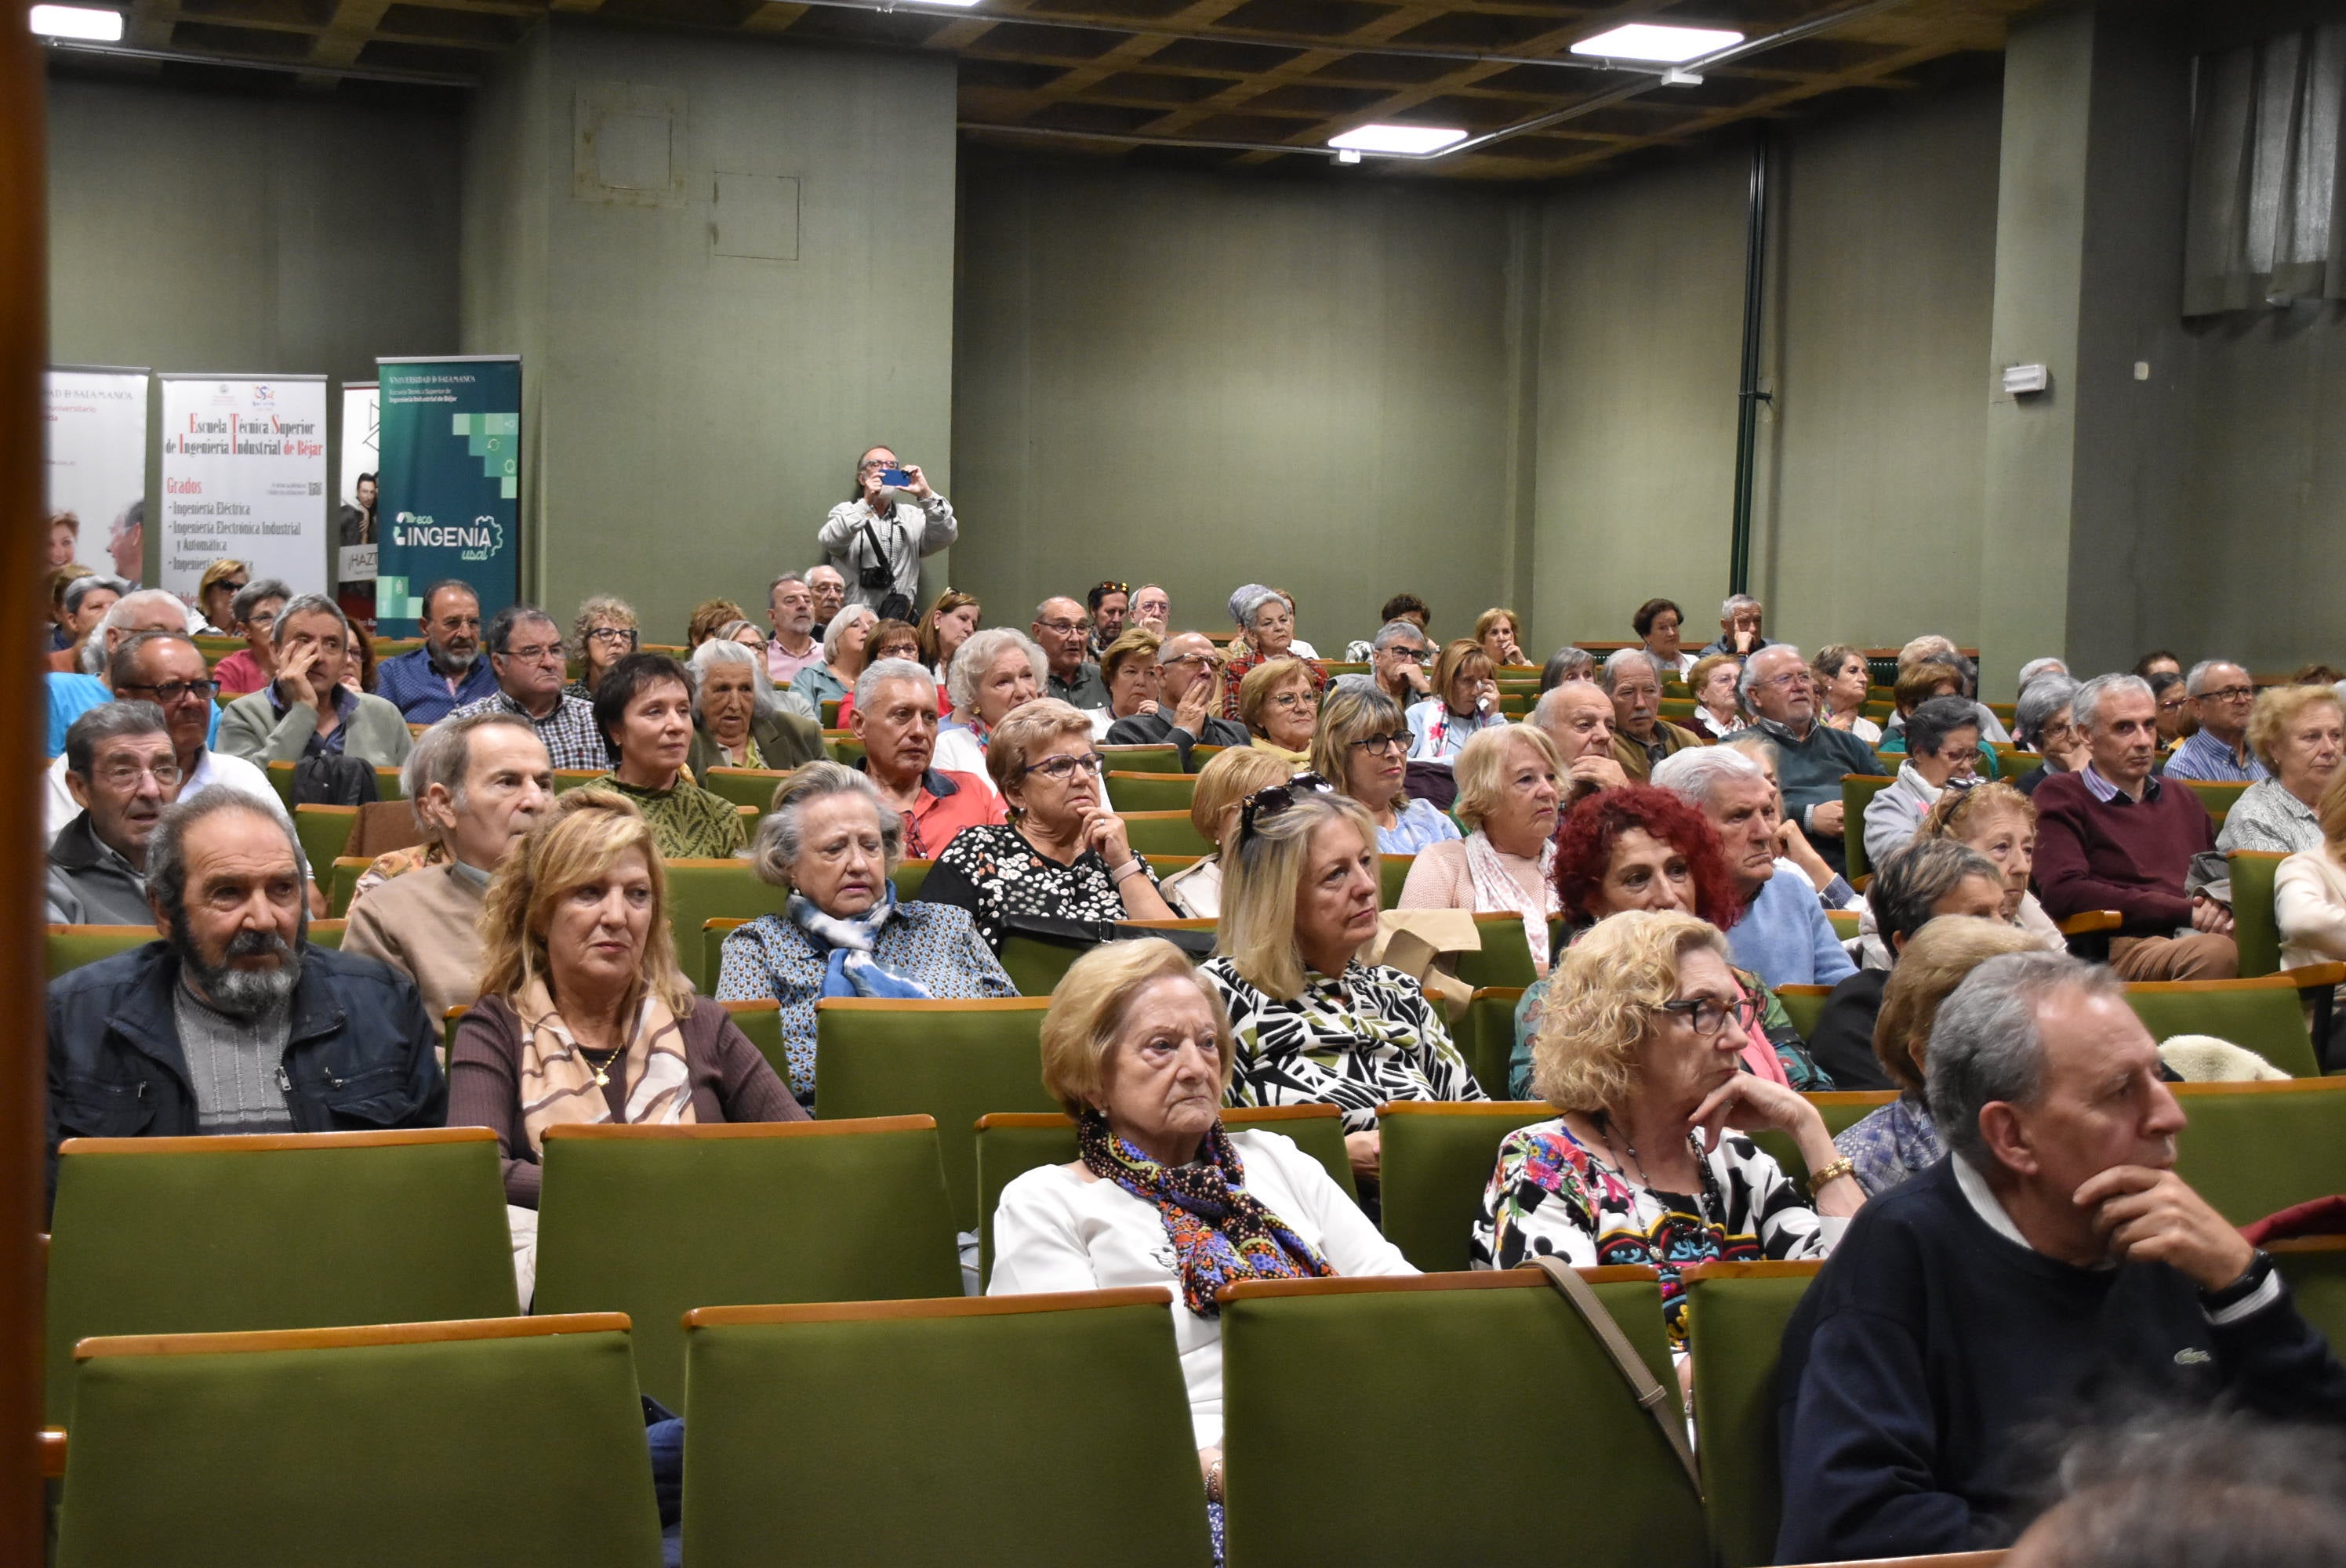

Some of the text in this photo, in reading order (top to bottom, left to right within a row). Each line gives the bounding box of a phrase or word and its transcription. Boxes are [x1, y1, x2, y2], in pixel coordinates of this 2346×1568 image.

[190, 413, 315, 437] Escuela Técnica Superior
[165, 439, 176, 453] de
[232, 434, 281, 455] Industrial
[284, 440, 294, 455] de
[297, 440, 323, 458] Béjar
[167, 477, 202, 494] Grados
[216, 501, 251, 515] Eléctrica
[416, 516, 434, 524] eco
[216, 521, 260, 535] Electrónica
[262, 521, 301, 535] Industrial
[408, 527, 492, 546] INGENIA
[183, 539, 227, 551] Automática
[461, 546, 488, 561] usal
